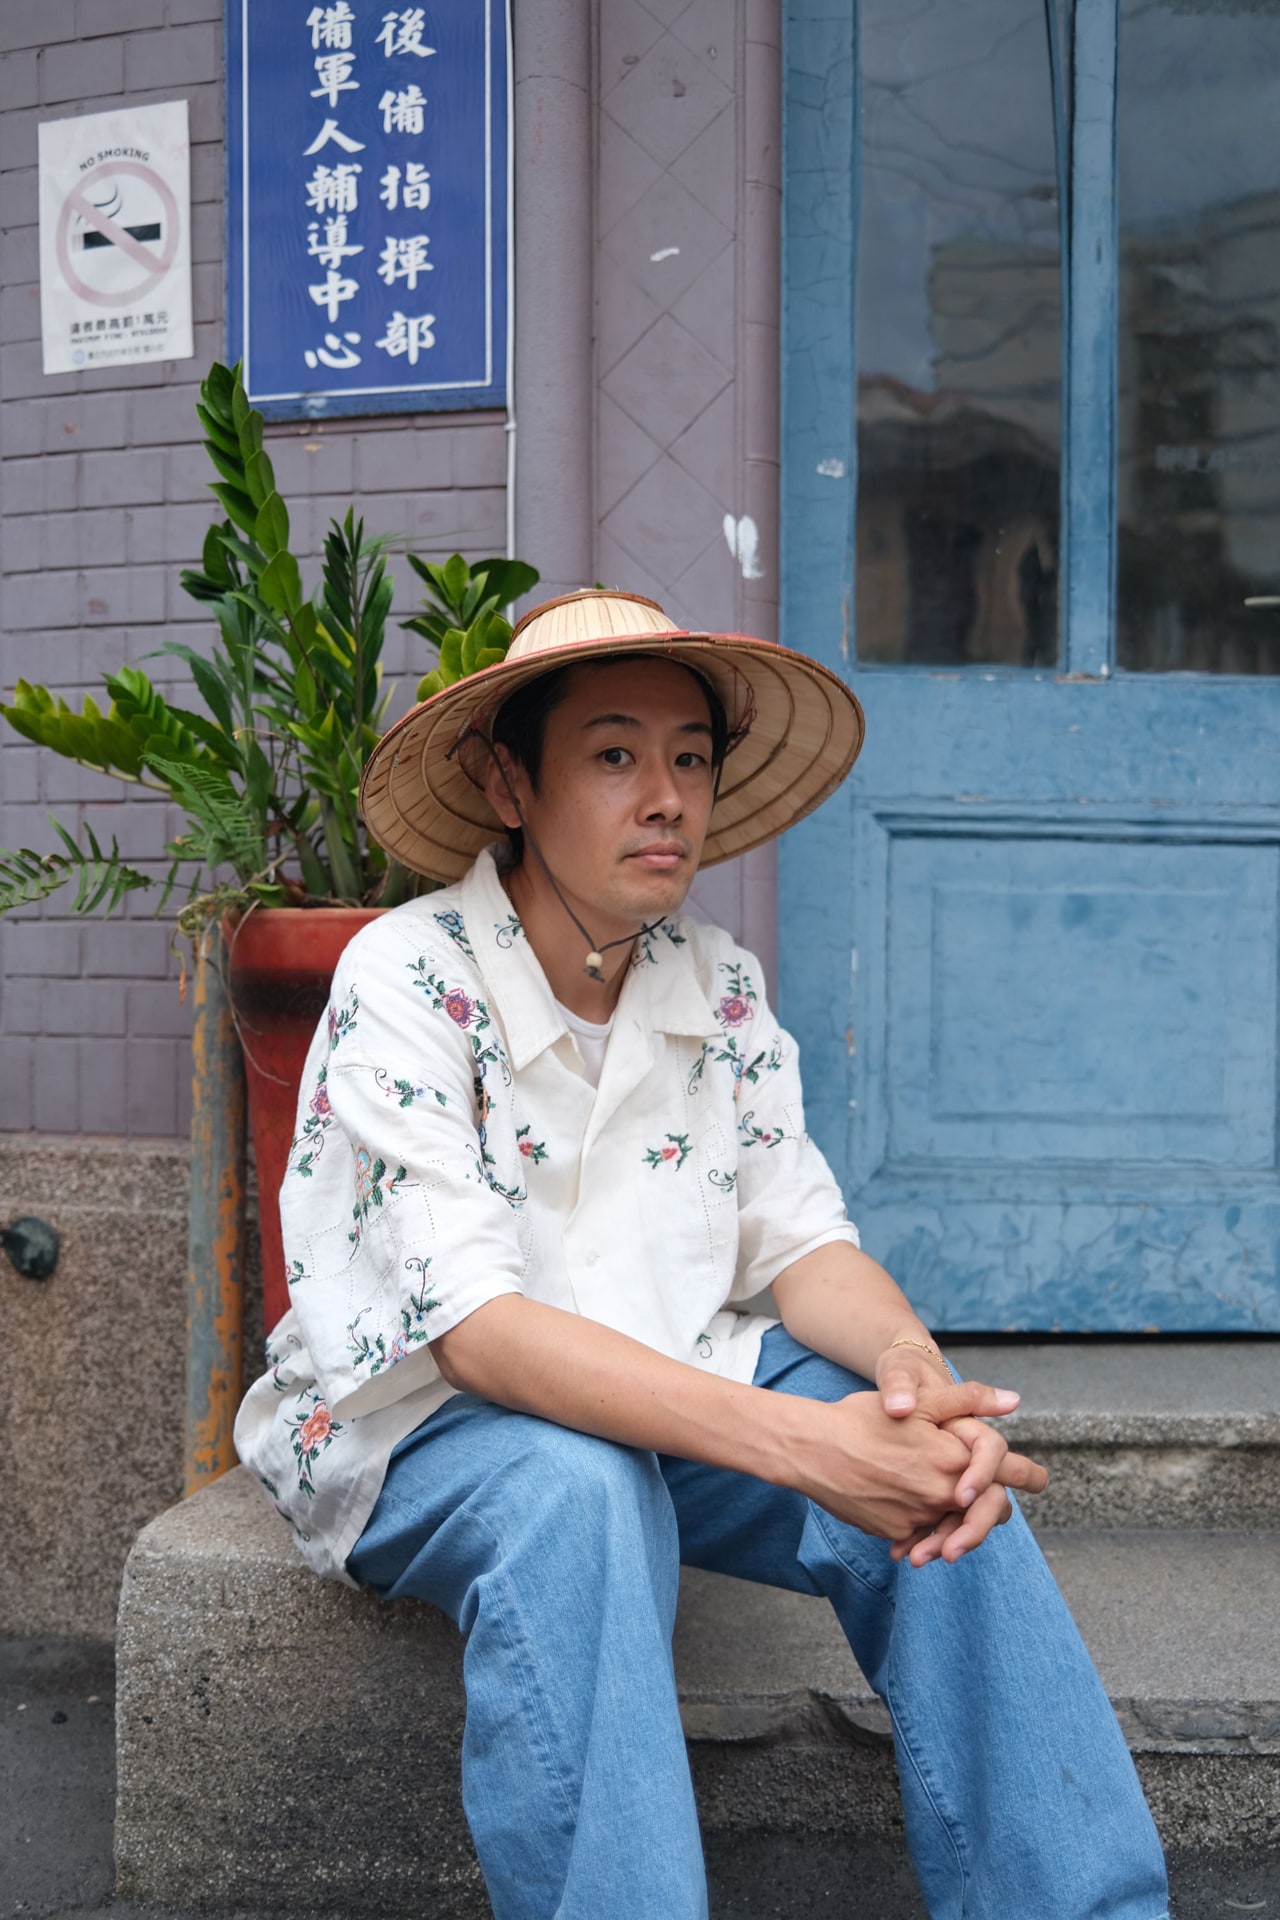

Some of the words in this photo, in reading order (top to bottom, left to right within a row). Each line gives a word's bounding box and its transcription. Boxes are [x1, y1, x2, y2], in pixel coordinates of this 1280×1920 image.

[80, 157, 95, 171] NO
[97, 148, 150, 162] SMOKING
[303, 1, 366, 369] 備軍人輔導中心
[375, 8, 437, 366] 後備指揮部
